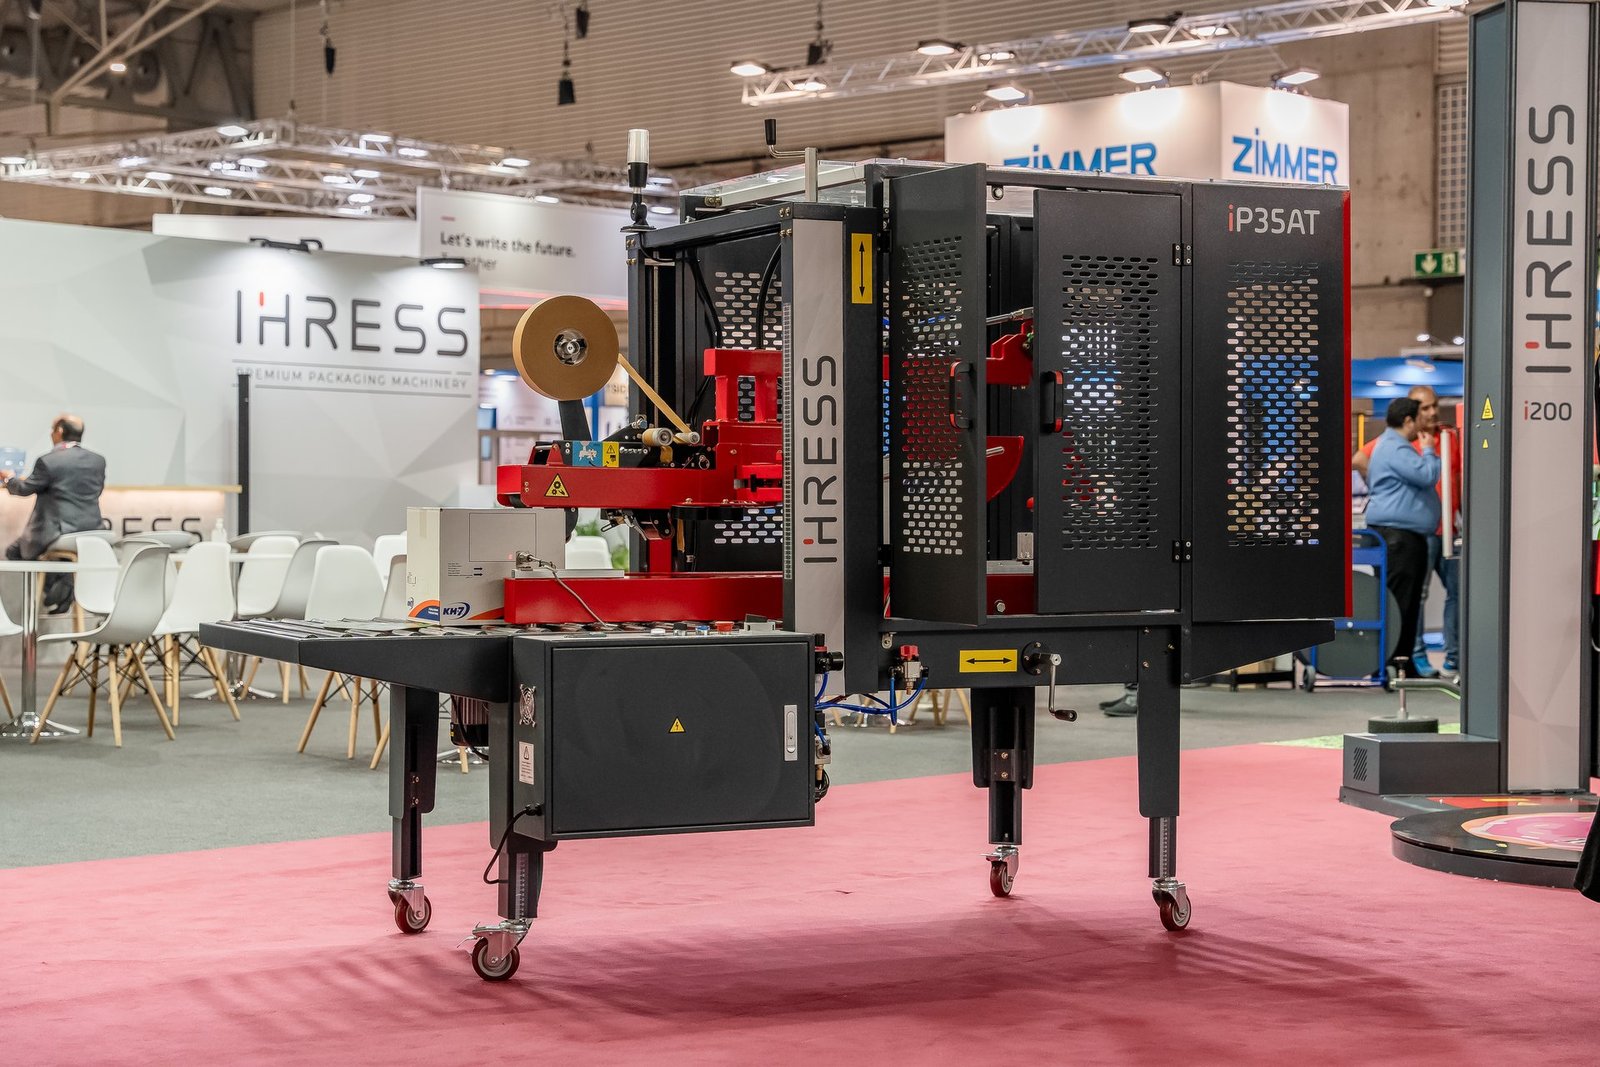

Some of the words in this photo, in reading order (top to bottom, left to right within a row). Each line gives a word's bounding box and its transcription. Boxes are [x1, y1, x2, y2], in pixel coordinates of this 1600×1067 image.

[1228, 204, 1321, 235] iP35AT
[440, 231, 471, 247] Let's
[475, 234, 507, 251] write
[511, 239, 532, 252] the
[1524, 104, 1575, 373] IHRESS
[236, 289, 469, 357] IHRESS
[308, 371, 386, 386] PACKAGING
[391, 375, 467, 389] MACHINERY
[1524, 401, 1573, 421] i200
[802, 355, 838, 563] IHRESS
